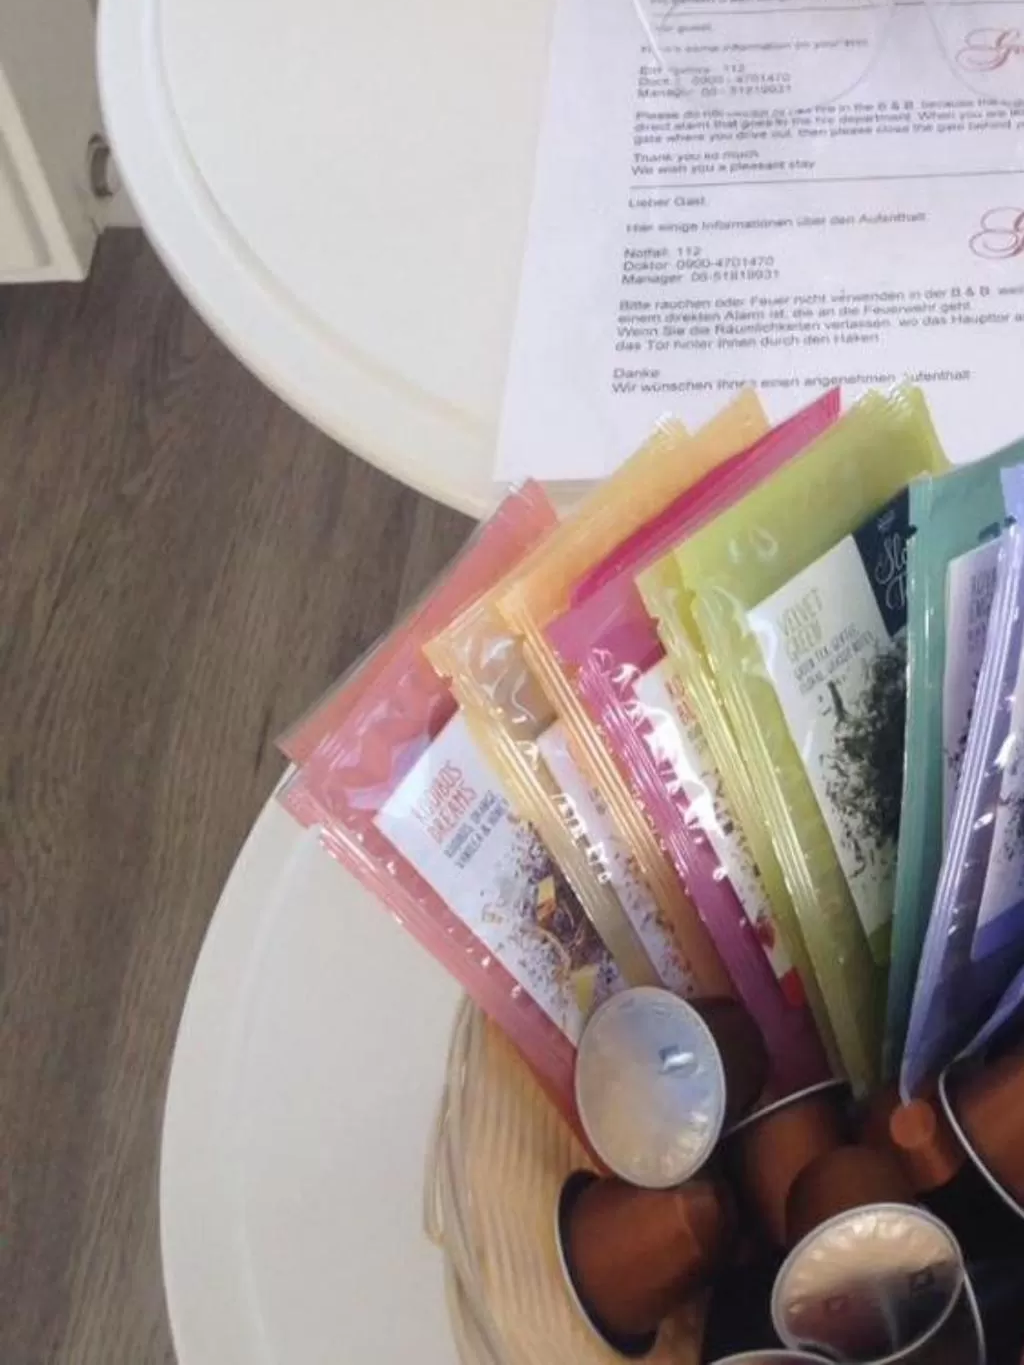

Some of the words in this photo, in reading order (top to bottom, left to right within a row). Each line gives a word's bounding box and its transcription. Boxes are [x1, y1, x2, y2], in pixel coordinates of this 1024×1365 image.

[633, 152, 672, 162] Thank
[676, 153, 701, 163] you
[631, 166, 654, 175] We
[690, 166, 714, 175] you
[730, 160, 784, 174] pleasant
[657, 220, 699, 234] einige
[702, 216, 794, 230] Informationen
[677, 246, 703, 257] 112
[619, 299, 651, 311] Bitte
[654, 296, 711, 309] rauchen
[714, 294, 745, 306] oder
[750, 292, 789, 305] Feuer
[793, 291, 826, 303] nicht
[830, 288, 905, 301] verwenden
[617, 312, 661, 324] einem
[664, 310, 721, 322] direkten
[724, 308, 765, 319] Alarm
[864, 302, 936, 314] Feuerwehr
[616, 326, 658, 338] Wenn
[661, 325, 685, 336] Sie
[615, 340, 642, 352] das
[647, 339, 671, 351] Tor
[716, 335, 757, 347] Ihnen
[760, 333, 801, 345] durch
[610, 382, 637, 394] Wir
[641, 378, 713, 393] wünschen
[803, 371, 897, 388] angenehmen
[902, 368, 971, 382] ufenthalt
[613, 365, 661, 379] Danke
[426, 785, 478, 845] DREAMS
